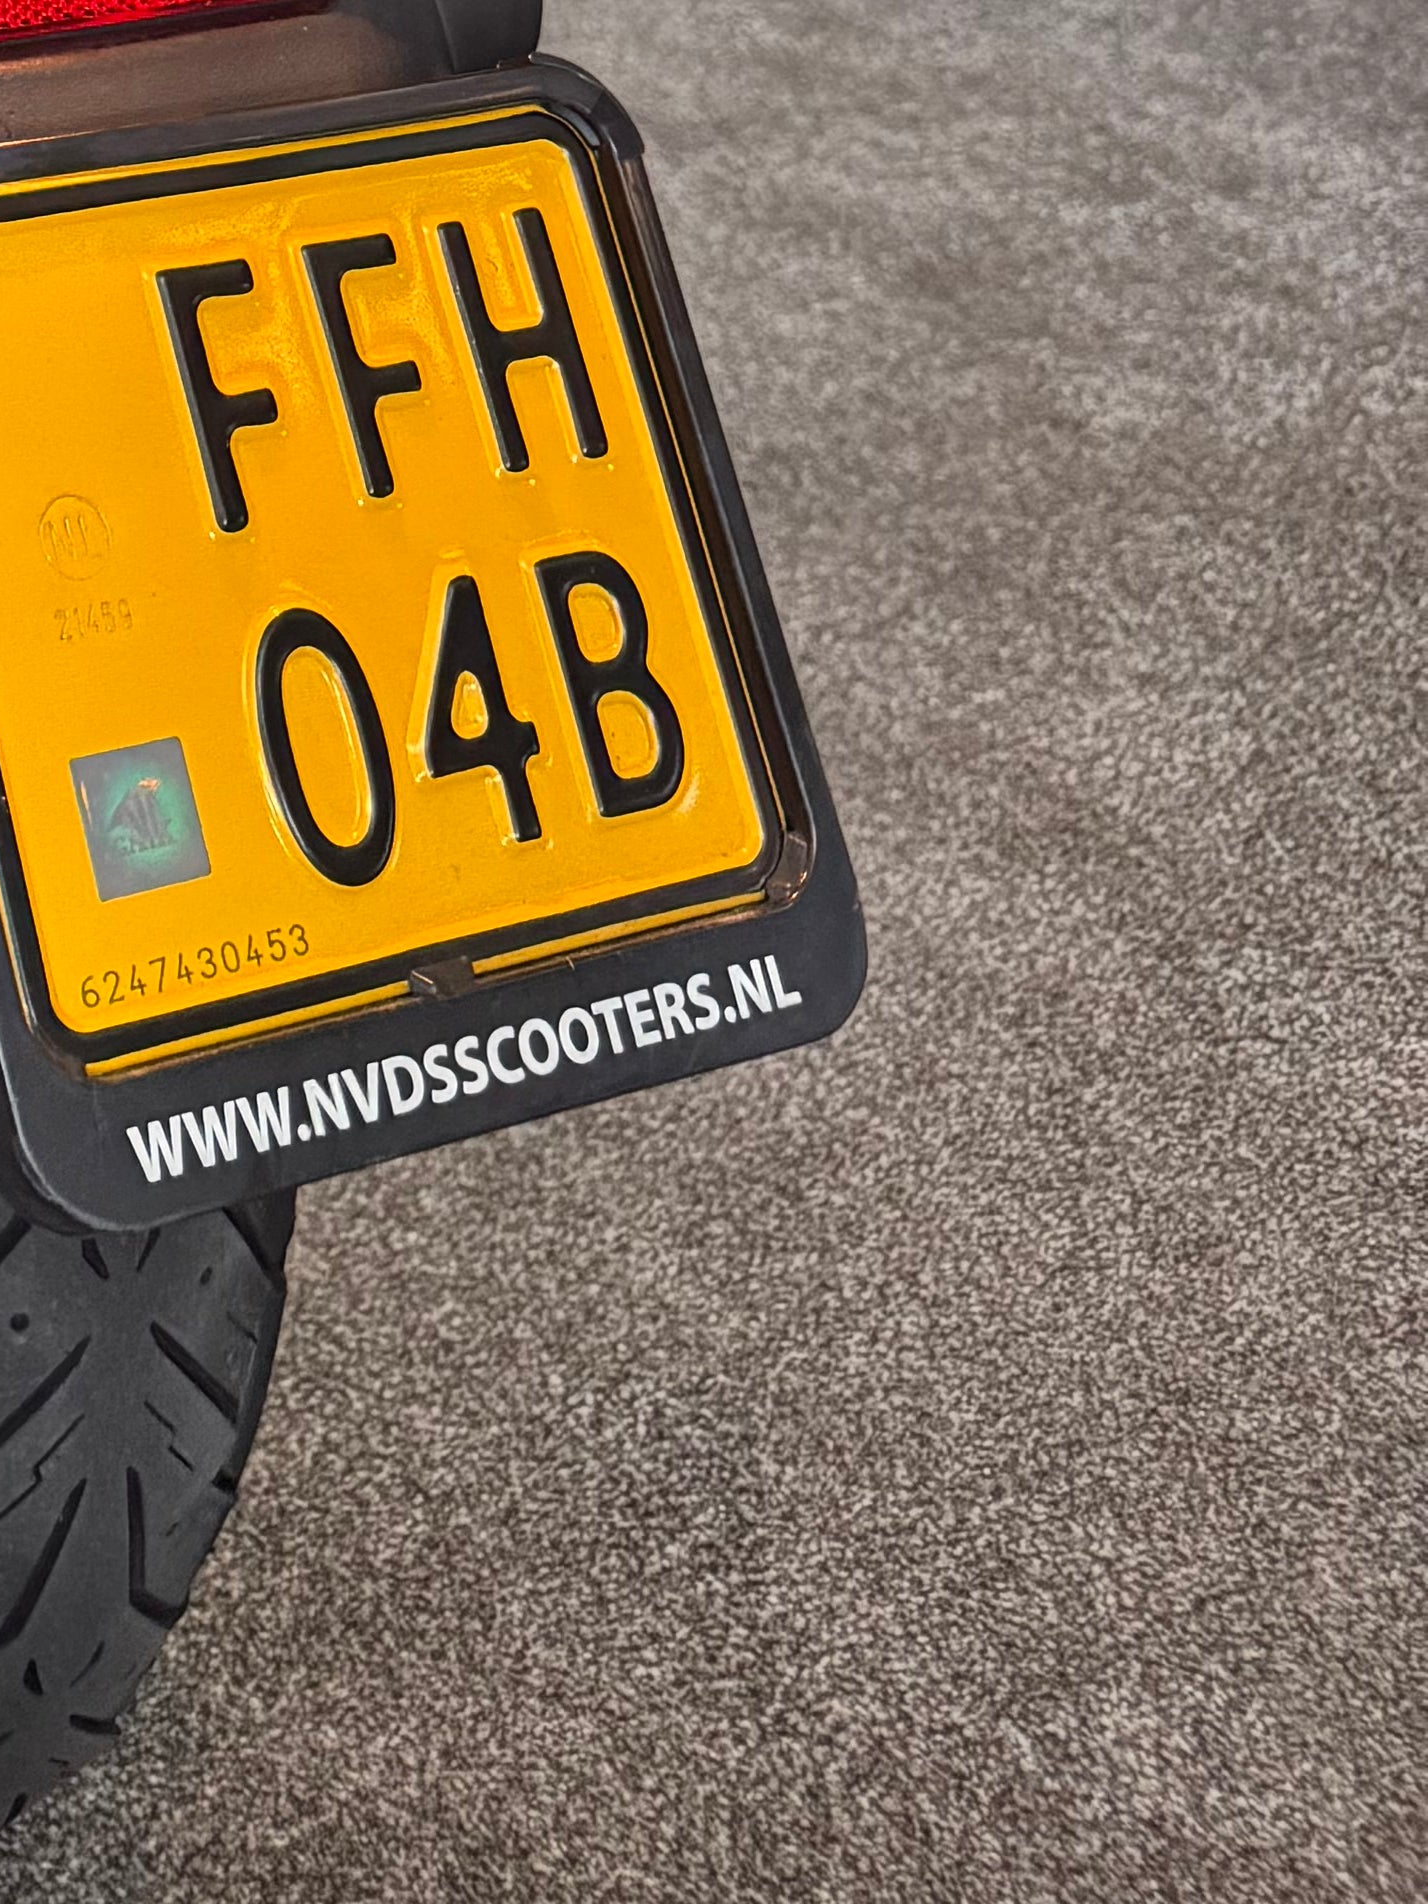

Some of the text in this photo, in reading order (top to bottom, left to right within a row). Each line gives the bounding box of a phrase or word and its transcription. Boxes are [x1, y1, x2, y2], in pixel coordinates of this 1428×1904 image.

[156, 206, 608, 533] FFH
[254, 550, 686, 888] 04B
[81, 924, 309, 1008] 6247430453
[126, 954, 803, 1184] WWW.NVDSSCOOTERS.NL
